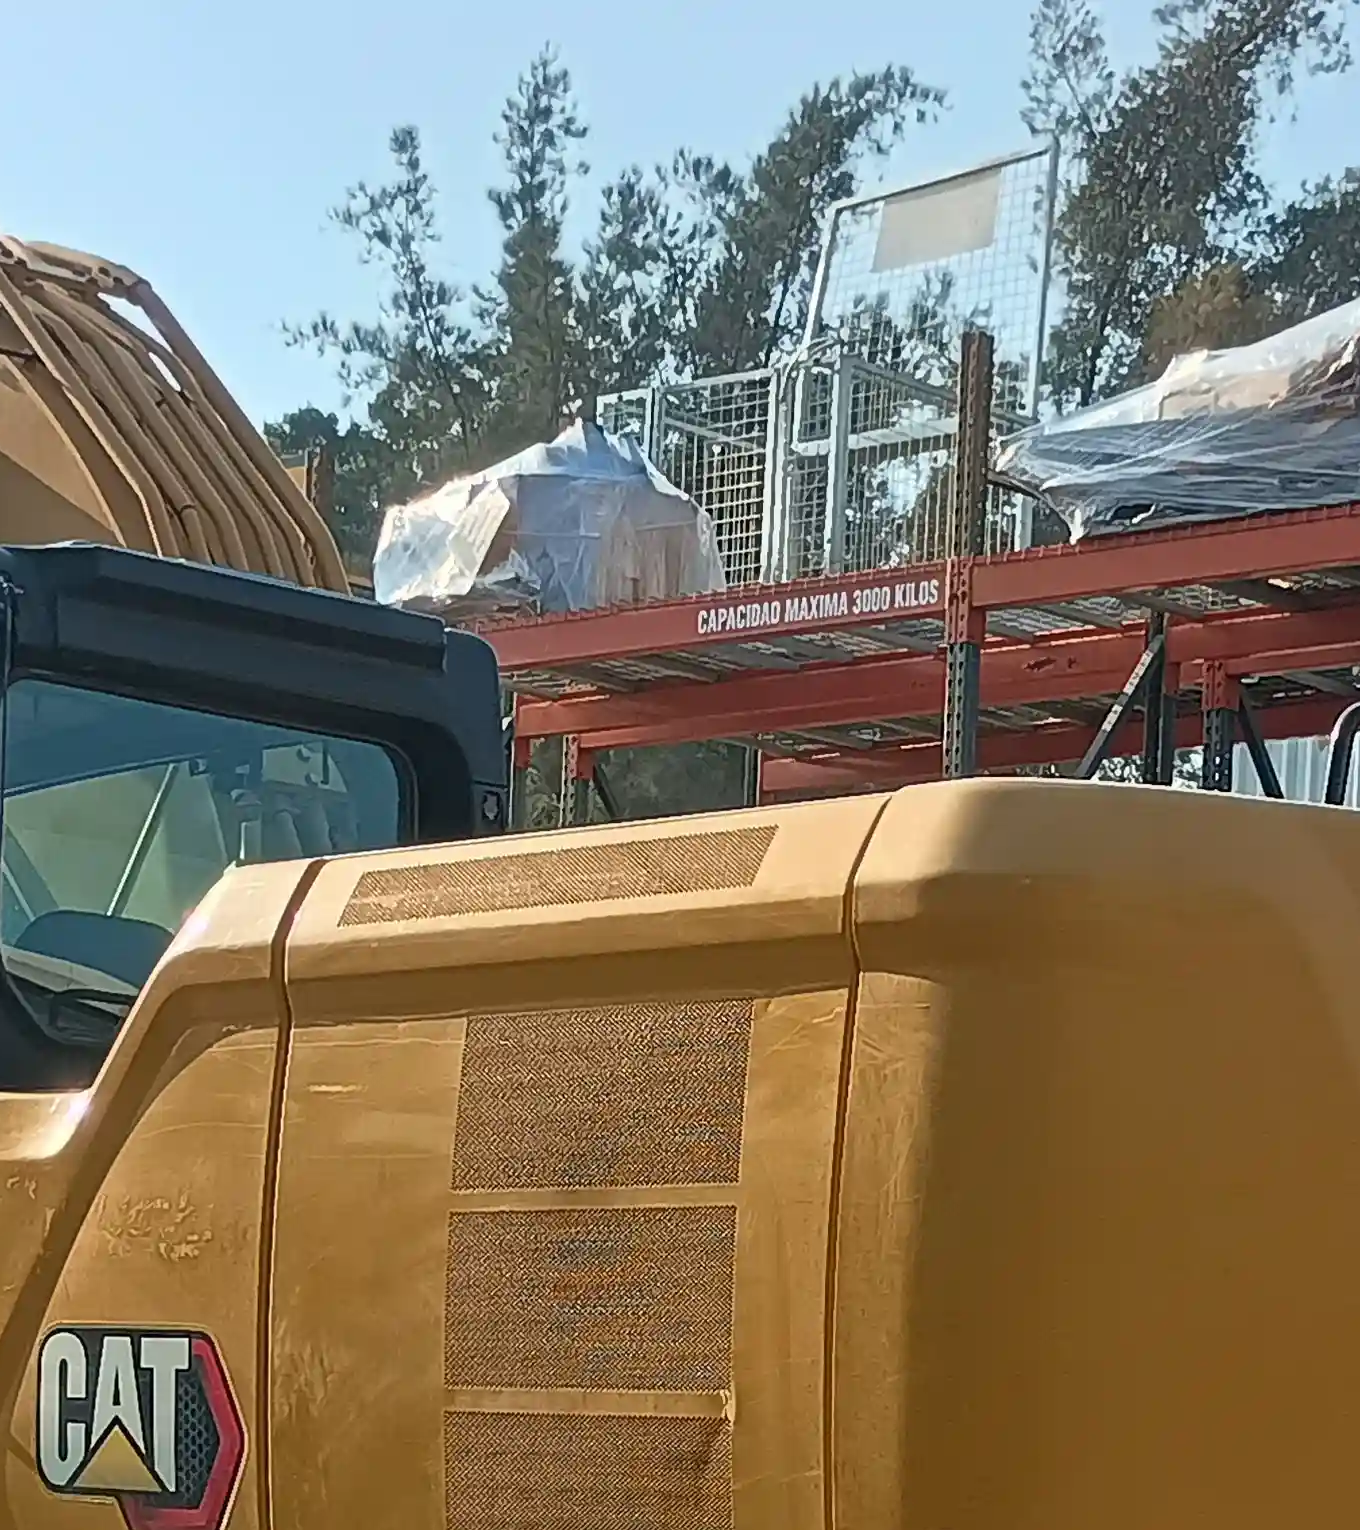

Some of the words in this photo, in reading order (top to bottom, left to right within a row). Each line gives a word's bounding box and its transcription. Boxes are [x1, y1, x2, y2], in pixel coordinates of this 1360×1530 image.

[697, 601, 781, 635] CAPACIDAD
[784, 591, 848, 624] MAXIMA
[852, 586, 891, 614] 3000
[893, 578, 940, 608] KILOS
[40, 1331, 191, 1493] CAT
